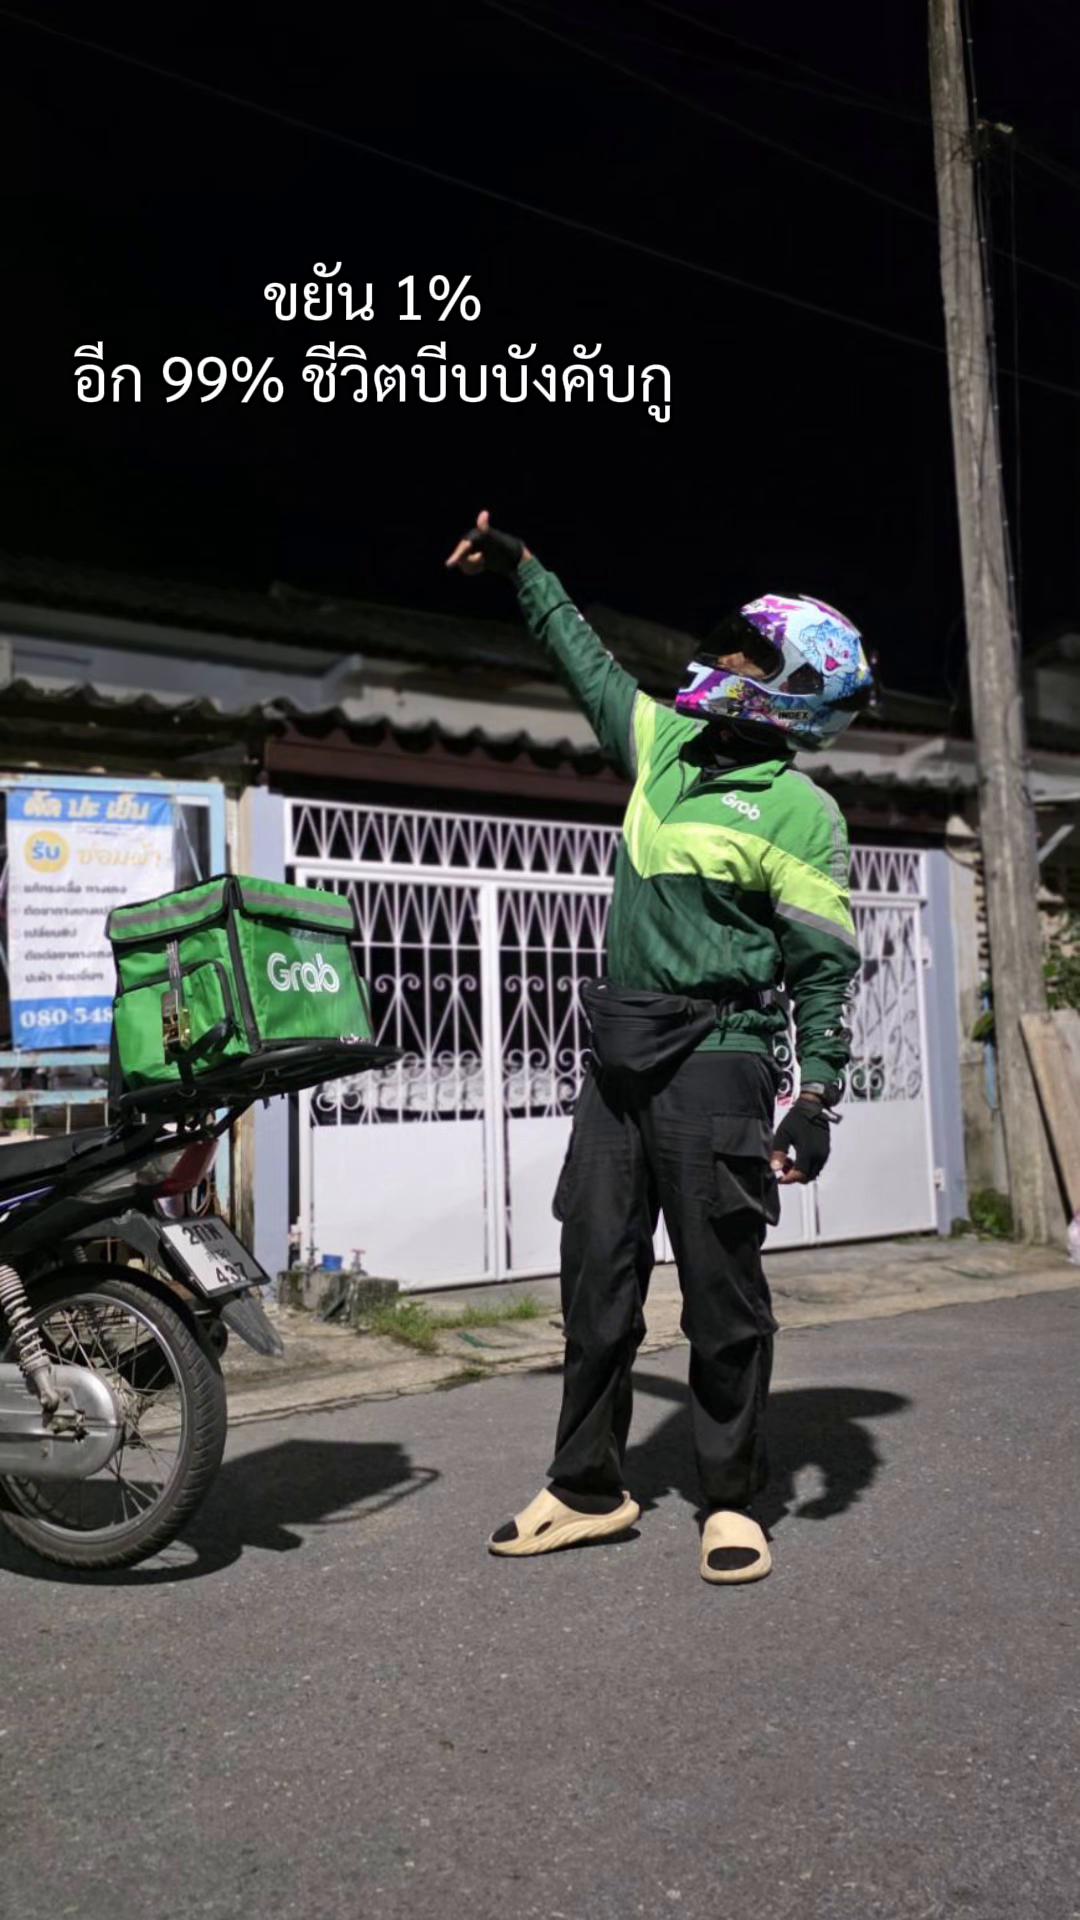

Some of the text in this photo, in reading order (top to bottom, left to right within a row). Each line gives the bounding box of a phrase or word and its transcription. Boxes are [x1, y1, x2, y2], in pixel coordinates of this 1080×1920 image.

[722, 791, 760, 820] Grab
[31, 840, 61, 860] รับ
[267, 952, 340, 993] Grab
[215, 1262, 249, 1284] 437
